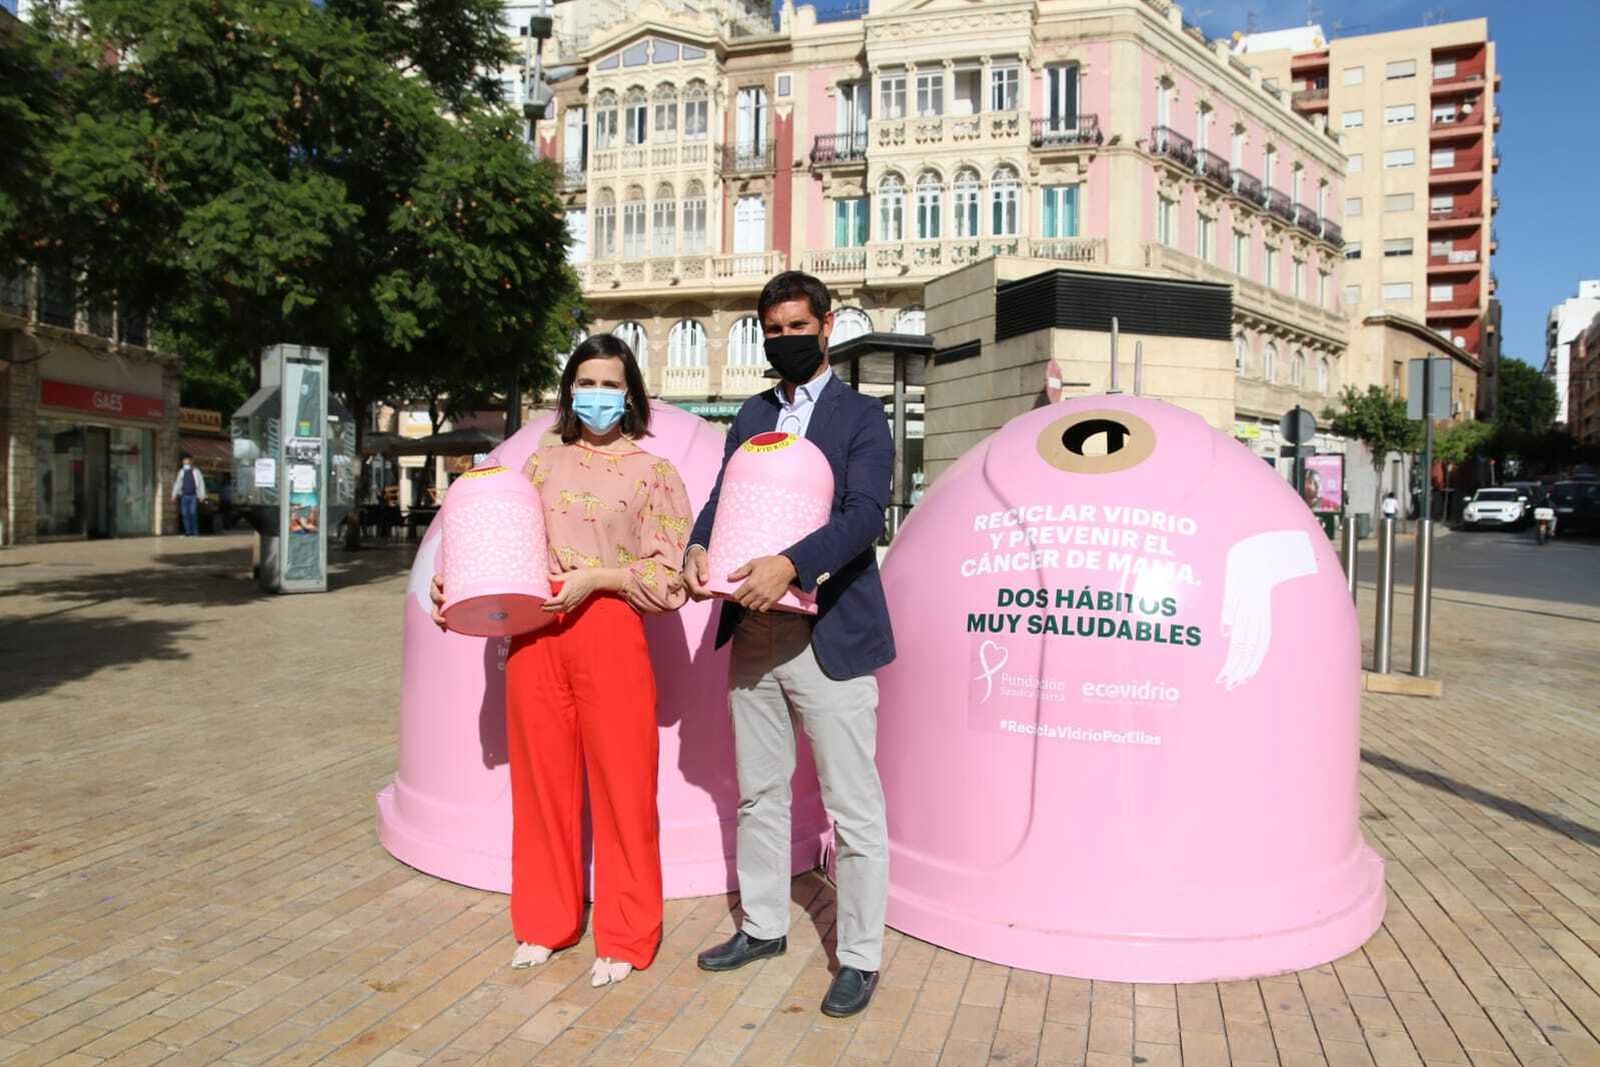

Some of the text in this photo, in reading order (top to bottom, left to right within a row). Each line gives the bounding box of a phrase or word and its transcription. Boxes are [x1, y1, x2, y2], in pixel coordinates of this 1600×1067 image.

[91, 391, 124, 412] GAES
[973, 504, 1198, 536] RECICLAR VIDRIO
[989, 526, 1176, 556] Y PREVENIR EL
[960, 549, 1059, 577] CÁNCER
[1066, 550, 1100, 570] DE
[997, 585, 1177, 617] DOS HÁBITOS
[967, 613, 1201, 647] MUY SALUDABLES
[1082, 680, 1180, 702] ecovidrio
